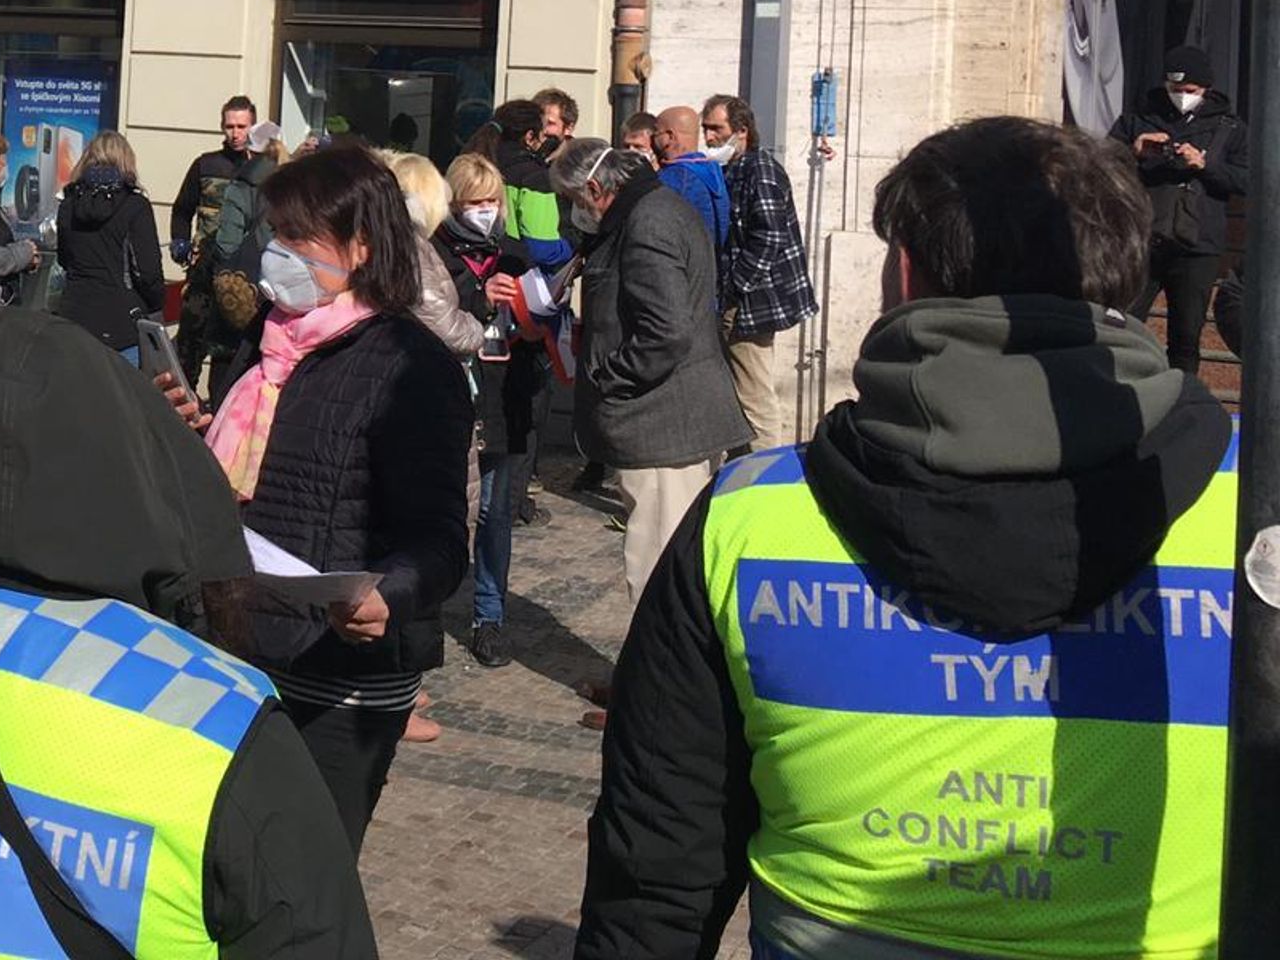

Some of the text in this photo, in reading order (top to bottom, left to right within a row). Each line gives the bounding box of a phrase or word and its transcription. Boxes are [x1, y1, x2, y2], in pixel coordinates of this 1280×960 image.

[931, 641, 1061, 703] TÝM
[937, 769, 1049, 810] ANTI
[862, 807, 1125, 865] CONFLICT
[922, 856, 1053, 902] TEAM
